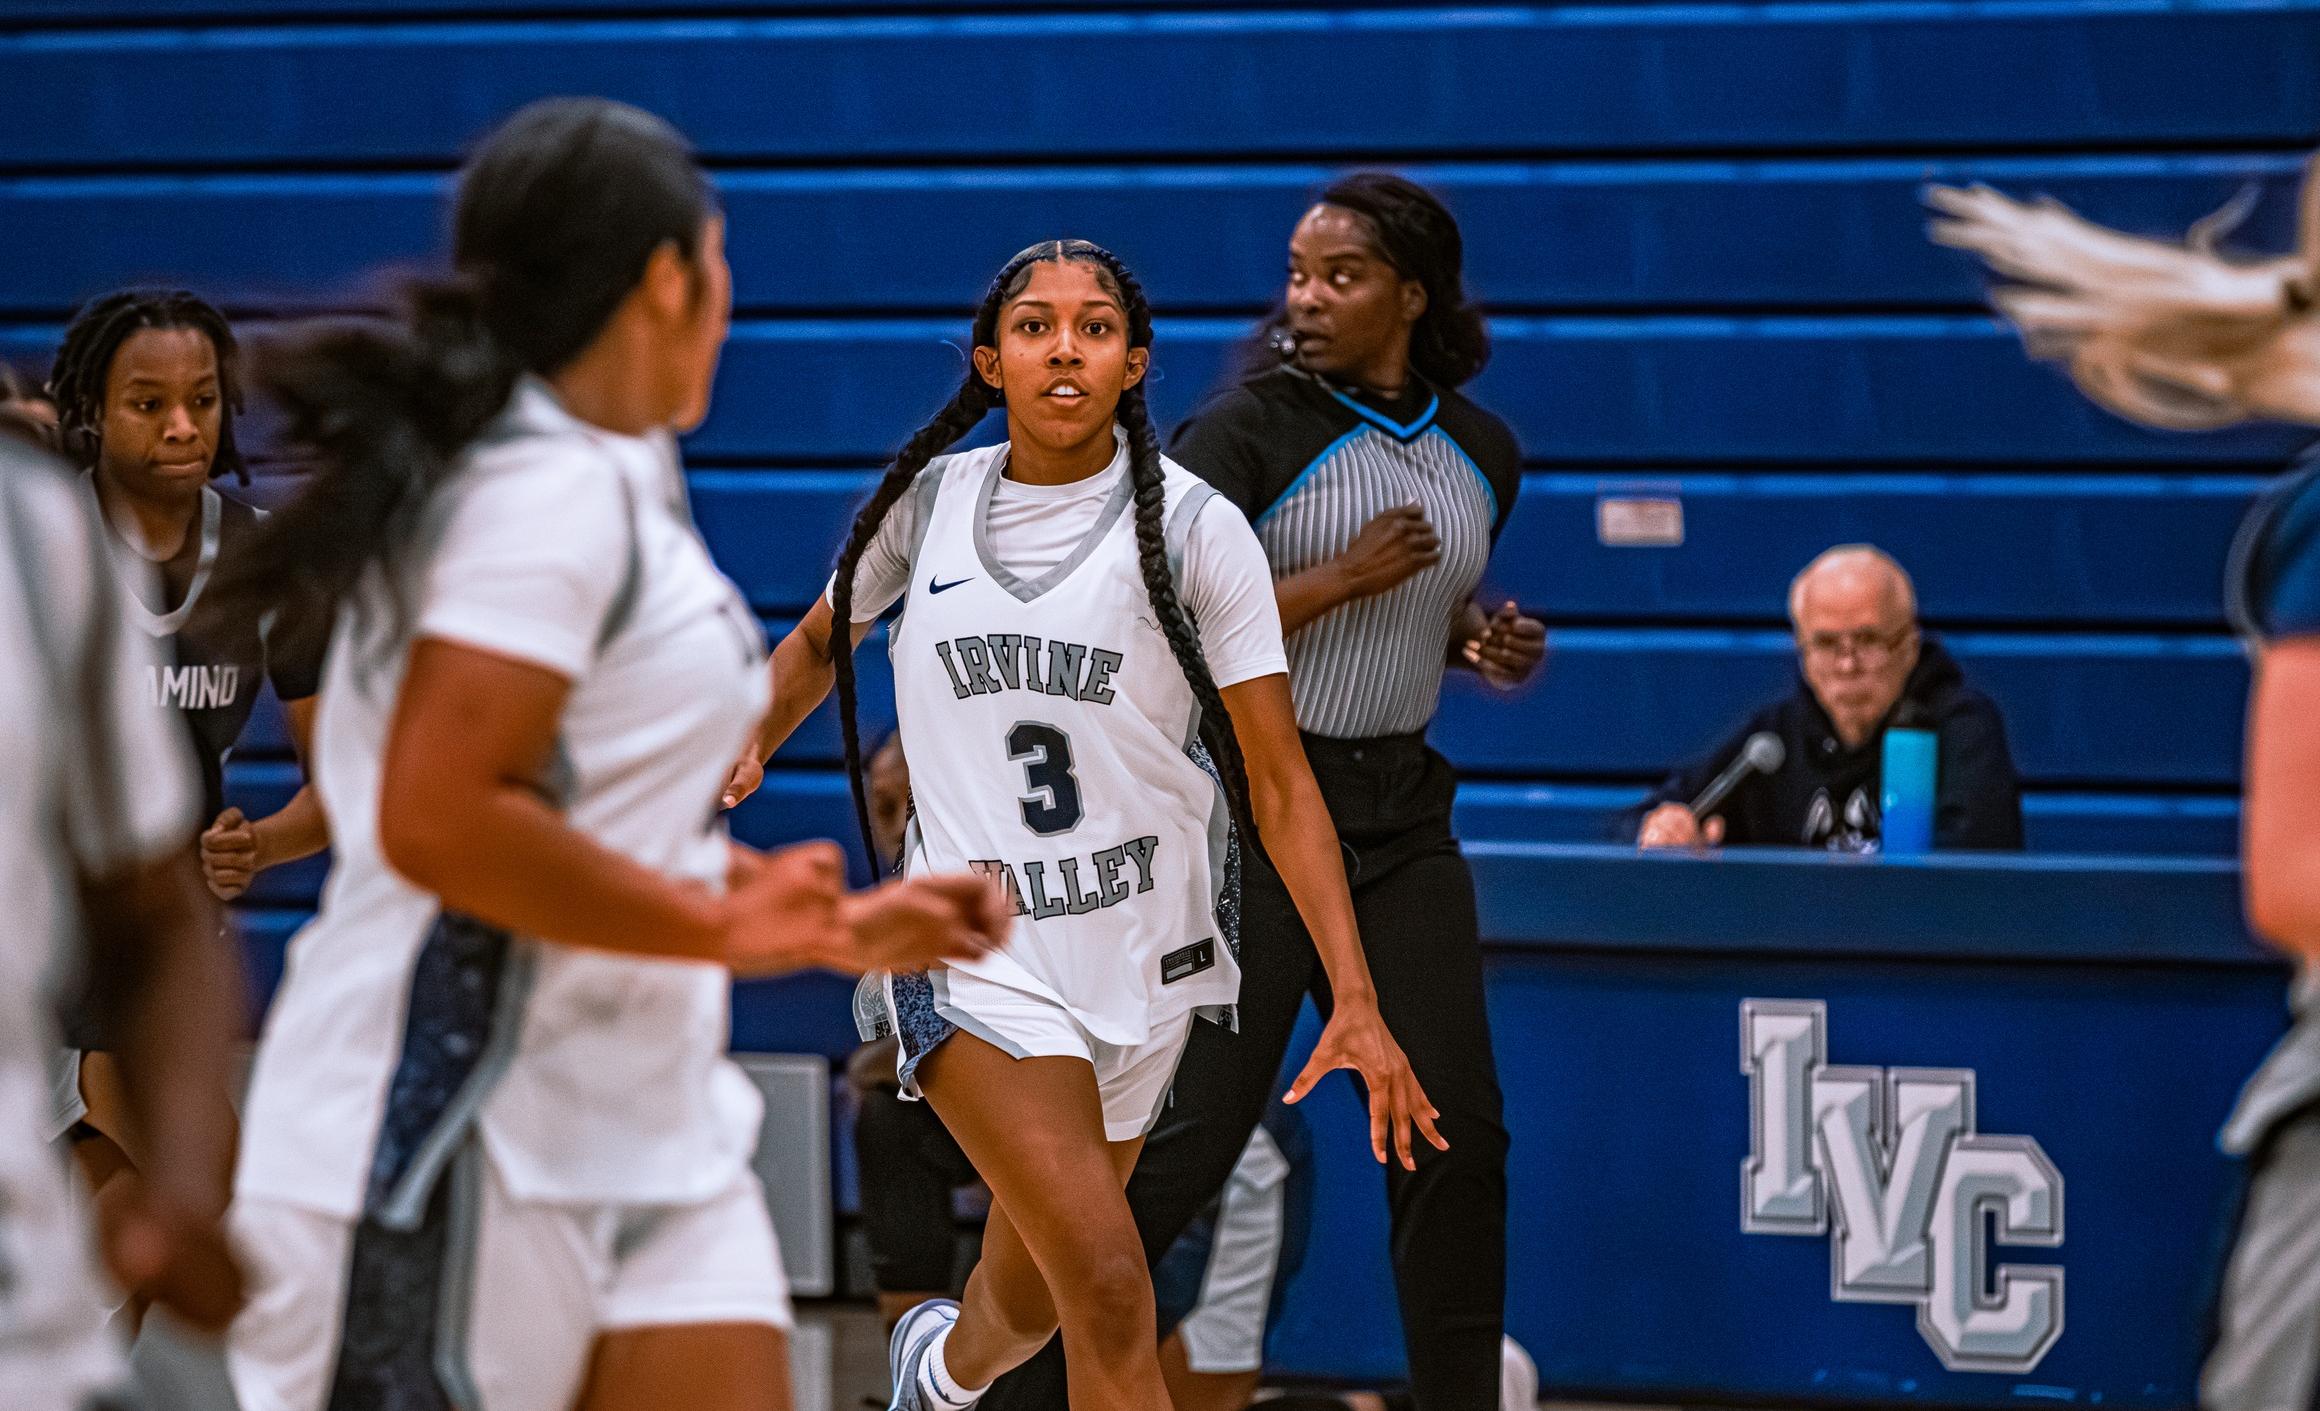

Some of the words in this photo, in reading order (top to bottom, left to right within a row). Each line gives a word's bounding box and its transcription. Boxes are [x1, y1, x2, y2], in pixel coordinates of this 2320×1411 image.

[936, 634, 1123, 705] IRVINE
[1005, 720, 1085, 838] 3
[1199, 950, 1206, 962] L
[1739, 998, 2065, 1373] IVC
